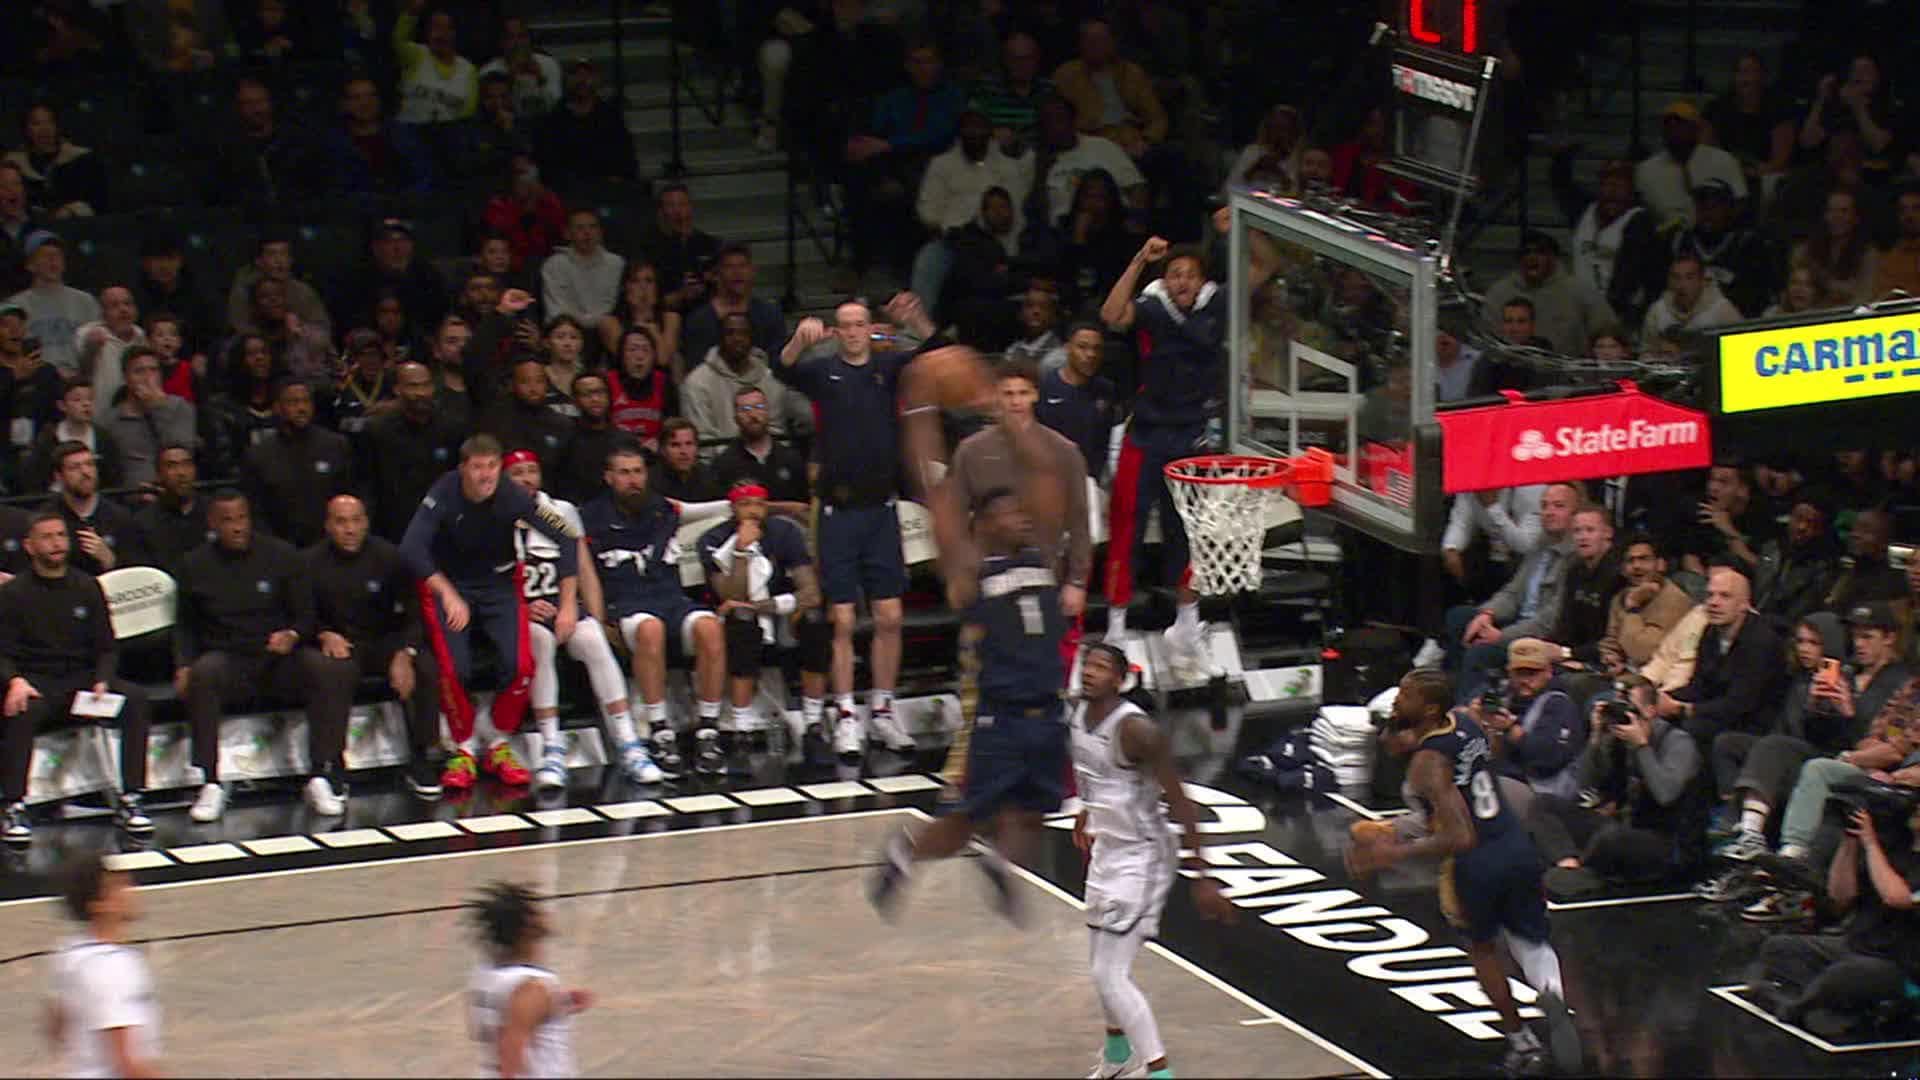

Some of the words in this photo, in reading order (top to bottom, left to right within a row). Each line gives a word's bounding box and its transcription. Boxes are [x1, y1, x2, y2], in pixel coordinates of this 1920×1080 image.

[1755, 329, 1920, 377] CARma
[522, 562, 560, 598] 22
[1016, 594, 1045, 635] 1
[1471, 770, 1500, 819] 8
